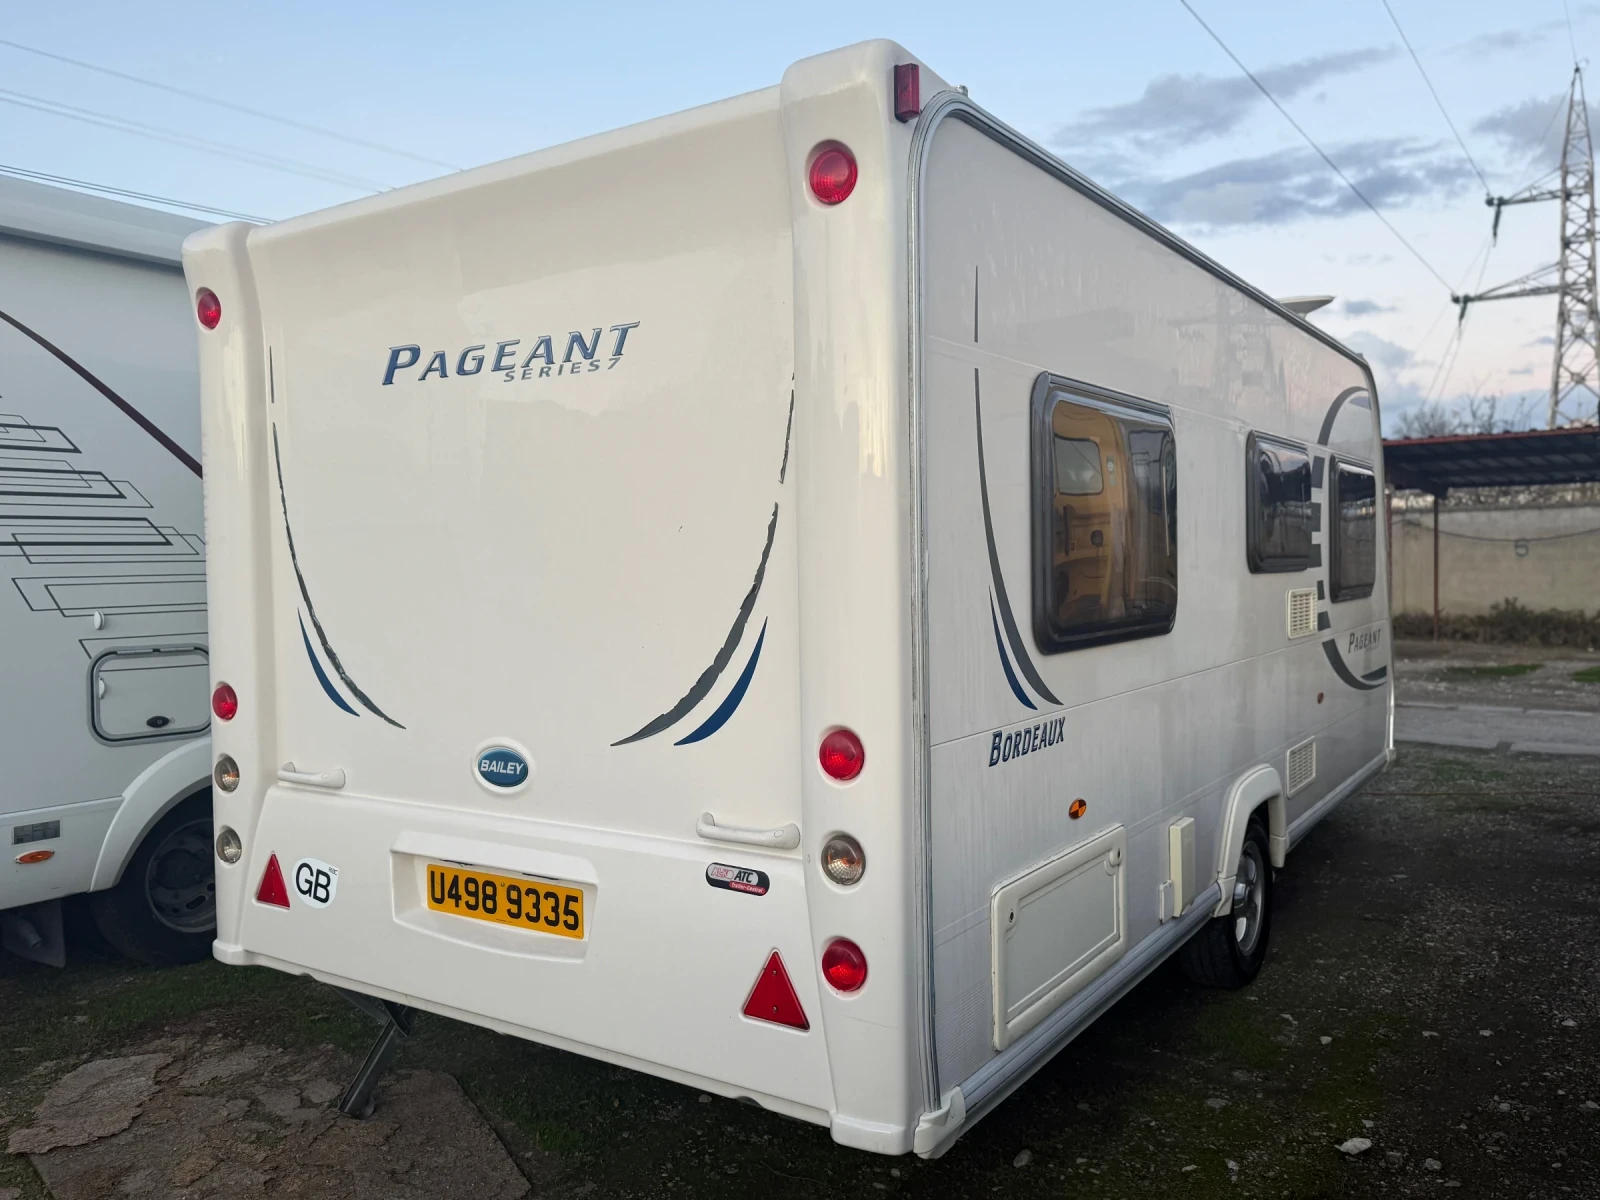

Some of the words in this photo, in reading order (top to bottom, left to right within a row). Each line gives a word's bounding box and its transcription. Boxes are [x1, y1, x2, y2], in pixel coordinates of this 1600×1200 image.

[382, 320, 640, 385] PAGEANT
[988, 716, 1066, 768] BORDEAUX
[480, 759, 525, 775] BAILEY
[295, 862, 331, 903] GB
[734, 870, 753, 883] ATC
[430, 870, 497, 915] U498
[506, 884, 579, 931] 9335
